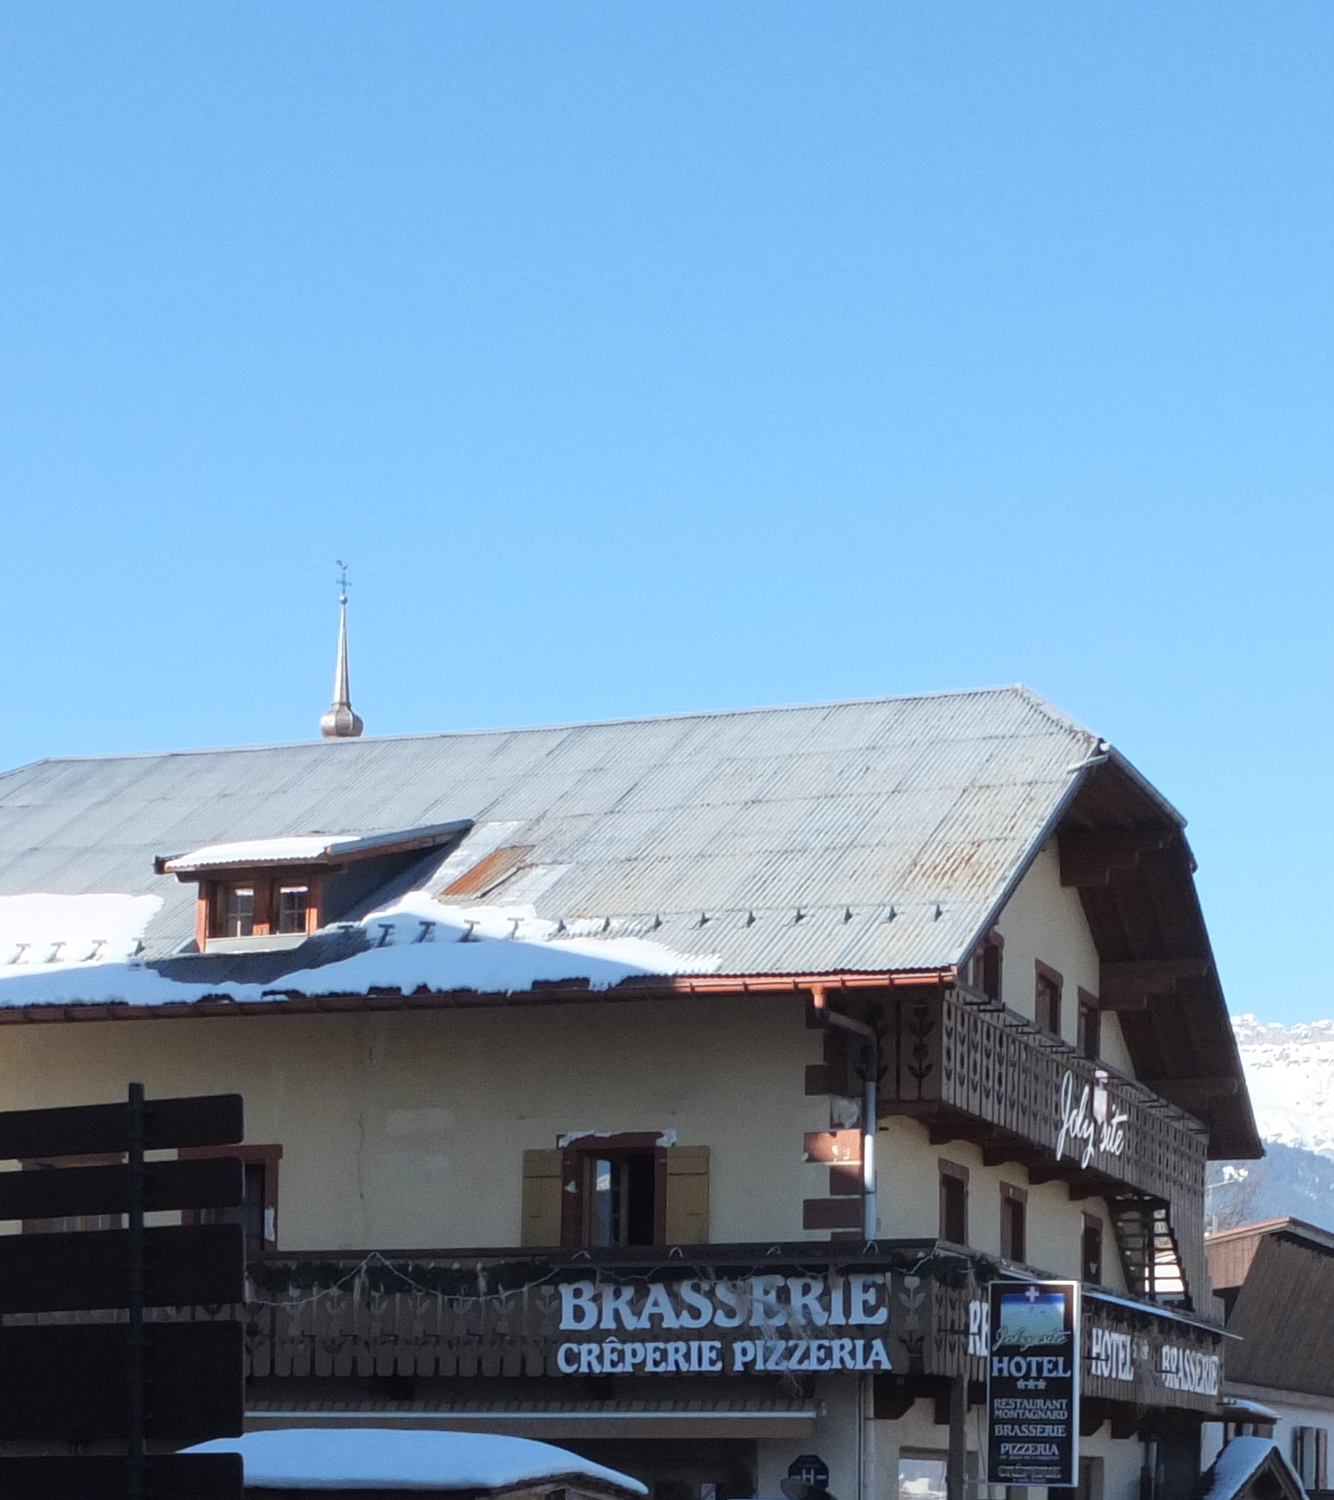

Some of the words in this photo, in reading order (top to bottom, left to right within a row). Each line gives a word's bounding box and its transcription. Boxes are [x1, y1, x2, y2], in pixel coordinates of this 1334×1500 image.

[1056, 1070, 1094, 1170] Joly
[1099, 1104, 1128, 1156] site
[558, 1273, 890, 1331] BRASSERIE
[557, 1336, 723, 1374] CRÊPERIE
[733, 1338, 893, 1372] PIZZERIA
[1091, 1327, 1134, 1381] HOTEL
[1161, 1345, 1219, 1396] BRASSERIE
[991, 1356, 1071, 1379] HOTEL
[993, 1398, 1068, 1410] RESTAURANT
[993, 1409, 1068, 1421] MONTAGNARD
[994, 1424, 1067, 1437] BRASSERIE
[999, 1443, 1060, 1456] PIZZERIA
